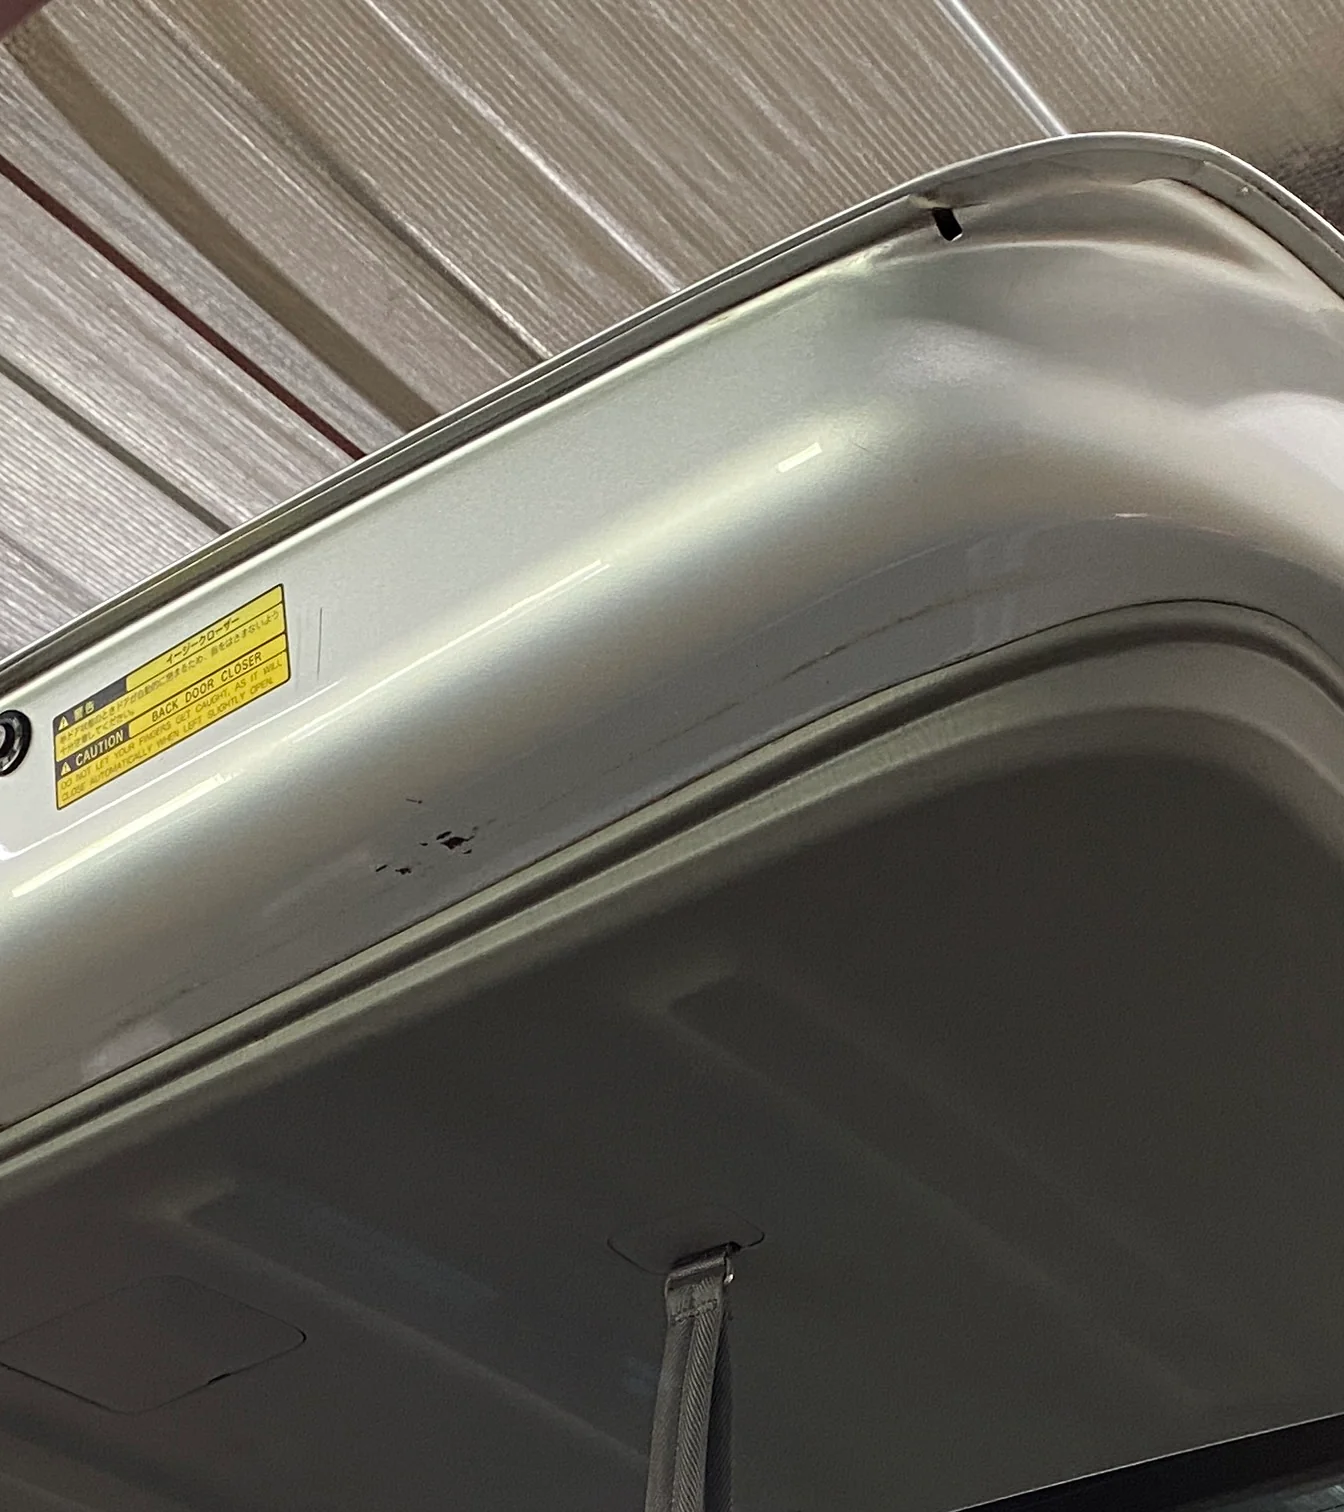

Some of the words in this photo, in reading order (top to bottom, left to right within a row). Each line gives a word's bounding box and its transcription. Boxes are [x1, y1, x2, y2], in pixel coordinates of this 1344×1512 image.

[165, 613, 240, 666] イージークローザー
[151, 696, 178, 723] BACK
[184, 676, 215, 704] DOOR
[219, 649, 262, 683] CLOSER
[60, 775, 72, 791] DO
[75, 765, 91, 782] NOT
[95, 755, 109, 771] LET
[114, 740, 135, 760] YOUR
[138, 720, 171, 746] FINGERS
[175, 708, 191, 725] GET
[234, 677, 246, 692] AS
[250, 670, 258, 683] IT
[262, 656, 282, 676] WILL
[61, 781, 86, 802] CLOSE
[89, 742, 153, 786] AUTOMATICALLY
[155, 726, 180, 749] WHEN
[182, 714, 202, 733] LEFT
[206, 689, 246, 720] SLIGHTLY
[74, 728, 124, 768] CAUTION
